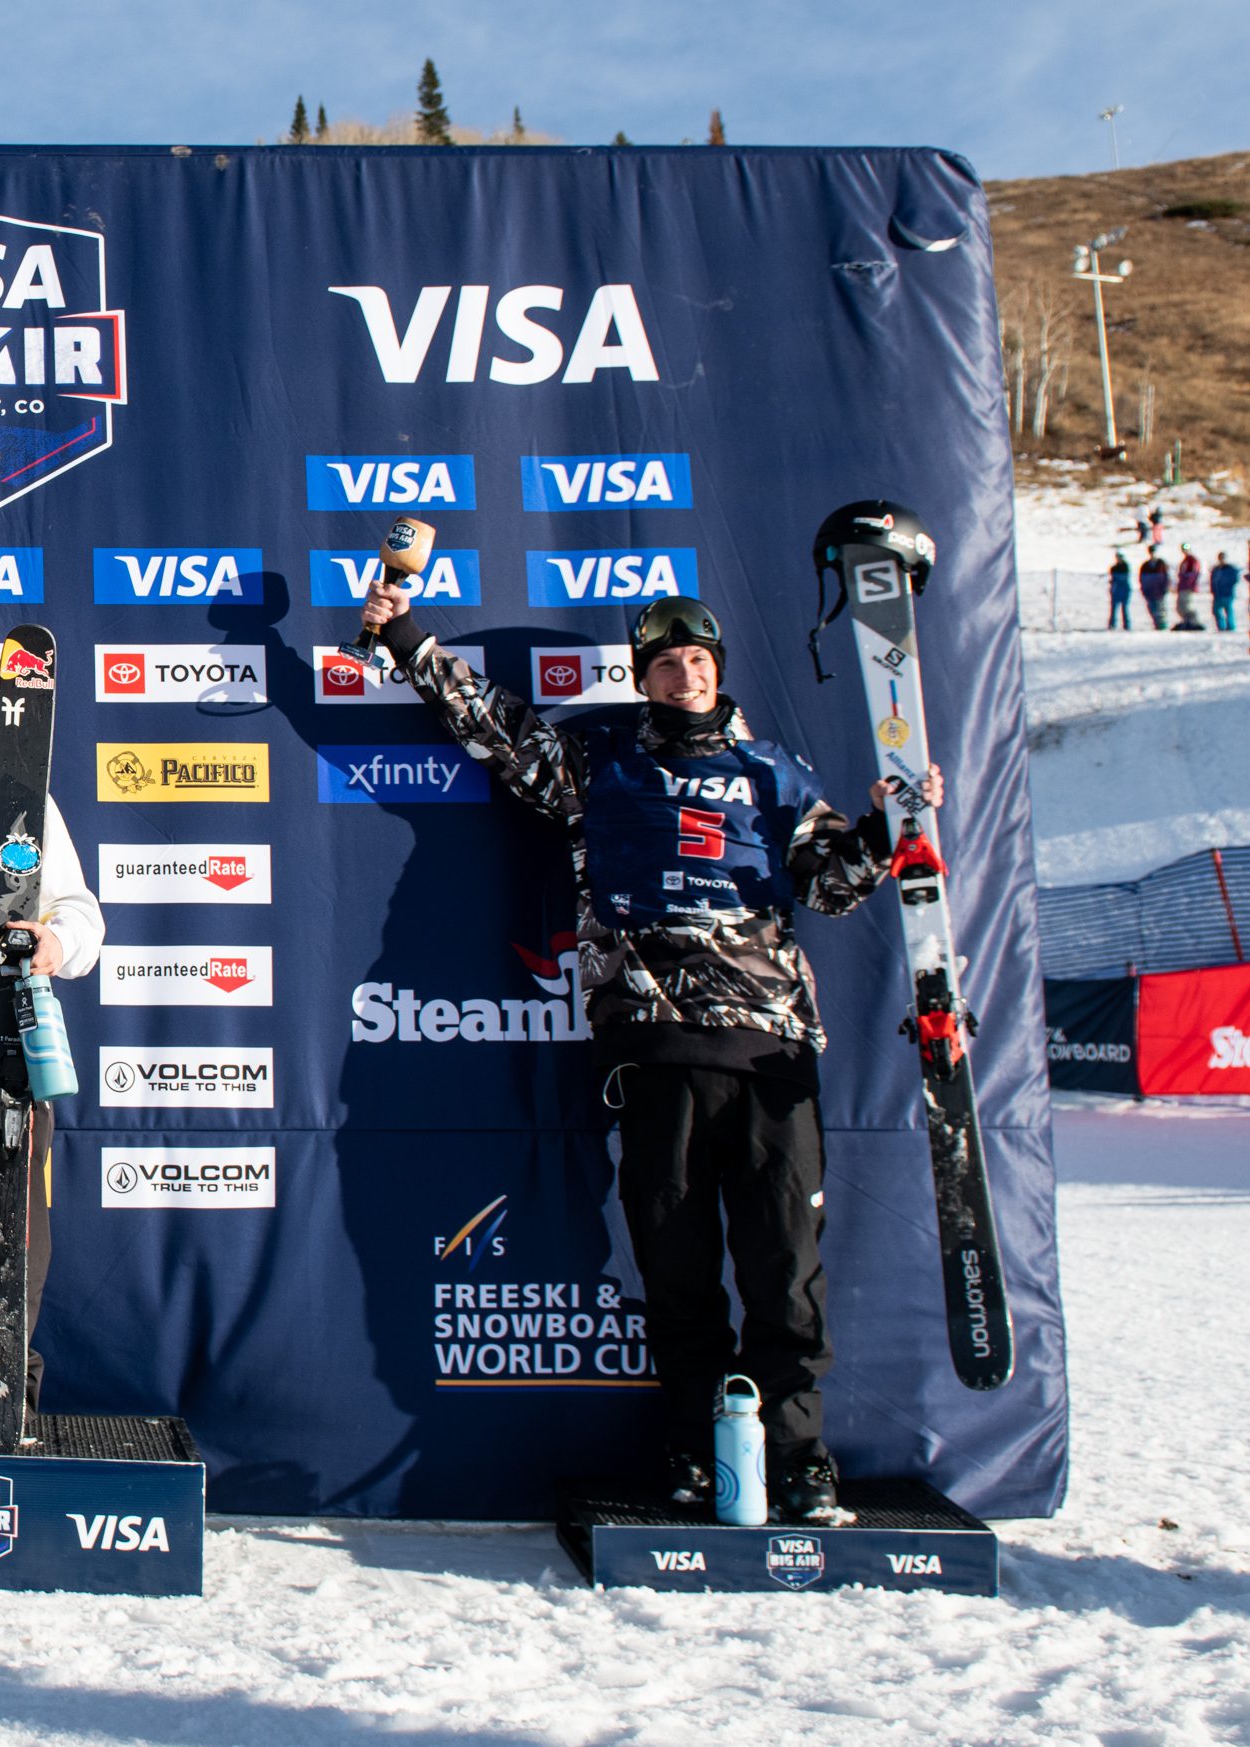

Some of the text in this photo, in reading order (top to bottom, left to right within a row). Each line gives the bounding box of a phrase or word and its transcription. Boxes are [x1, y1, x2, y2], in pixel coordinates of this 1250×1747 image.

[328, 284, 659, 385] VISA
[14, 400, 45, 413] CO
[326, 463, 456, 503] VISA
[541, 461, 673, 501] VISA
[115, 555, 243, 597] VISA
[547, 556, 680, 598] VISA
[155, 663, 258, 684] TOYOTA
[161, 759, 257, 786] PACIFICO
[348, 755, 461, 793] xfinity
[886, 751, 916, 779] Allianz
[654, 767, 753, 806] VISA
[678, 806, 726, 860] 5
[116, 860, 245, 878] guaranteed Rate
[687, 876, 737, 891] TOYOTA
[116, 961, 248, 980] guaranteed Rate
[1048, 1043, 1130, 1063] OWBOARD
[138, 1063, 267, 1081] VOLCOM
[149, 1082, 257, 1092] TRUE TO THIS
[139, 1164, 269, 1182] VOLCOM
[151, 1183, 259, 1193] TRUE TO THIS
[434, 1283, 621, 1309] FREESKI &
[960, 1249, 990, 1359] salomon
[434, 1313, 647, 1339] SNOWBOAR
[434, 1343, 657, 1375] WORLD CU
[66, 1514, 170, 1552] VISA
[777, 1540, 814, 1553] VISA
[650, 1551, 705, 1571] VISA
[770, 1554, 820, 1566] BIG AIR
[885, 1554, 942, 1574] VISA
